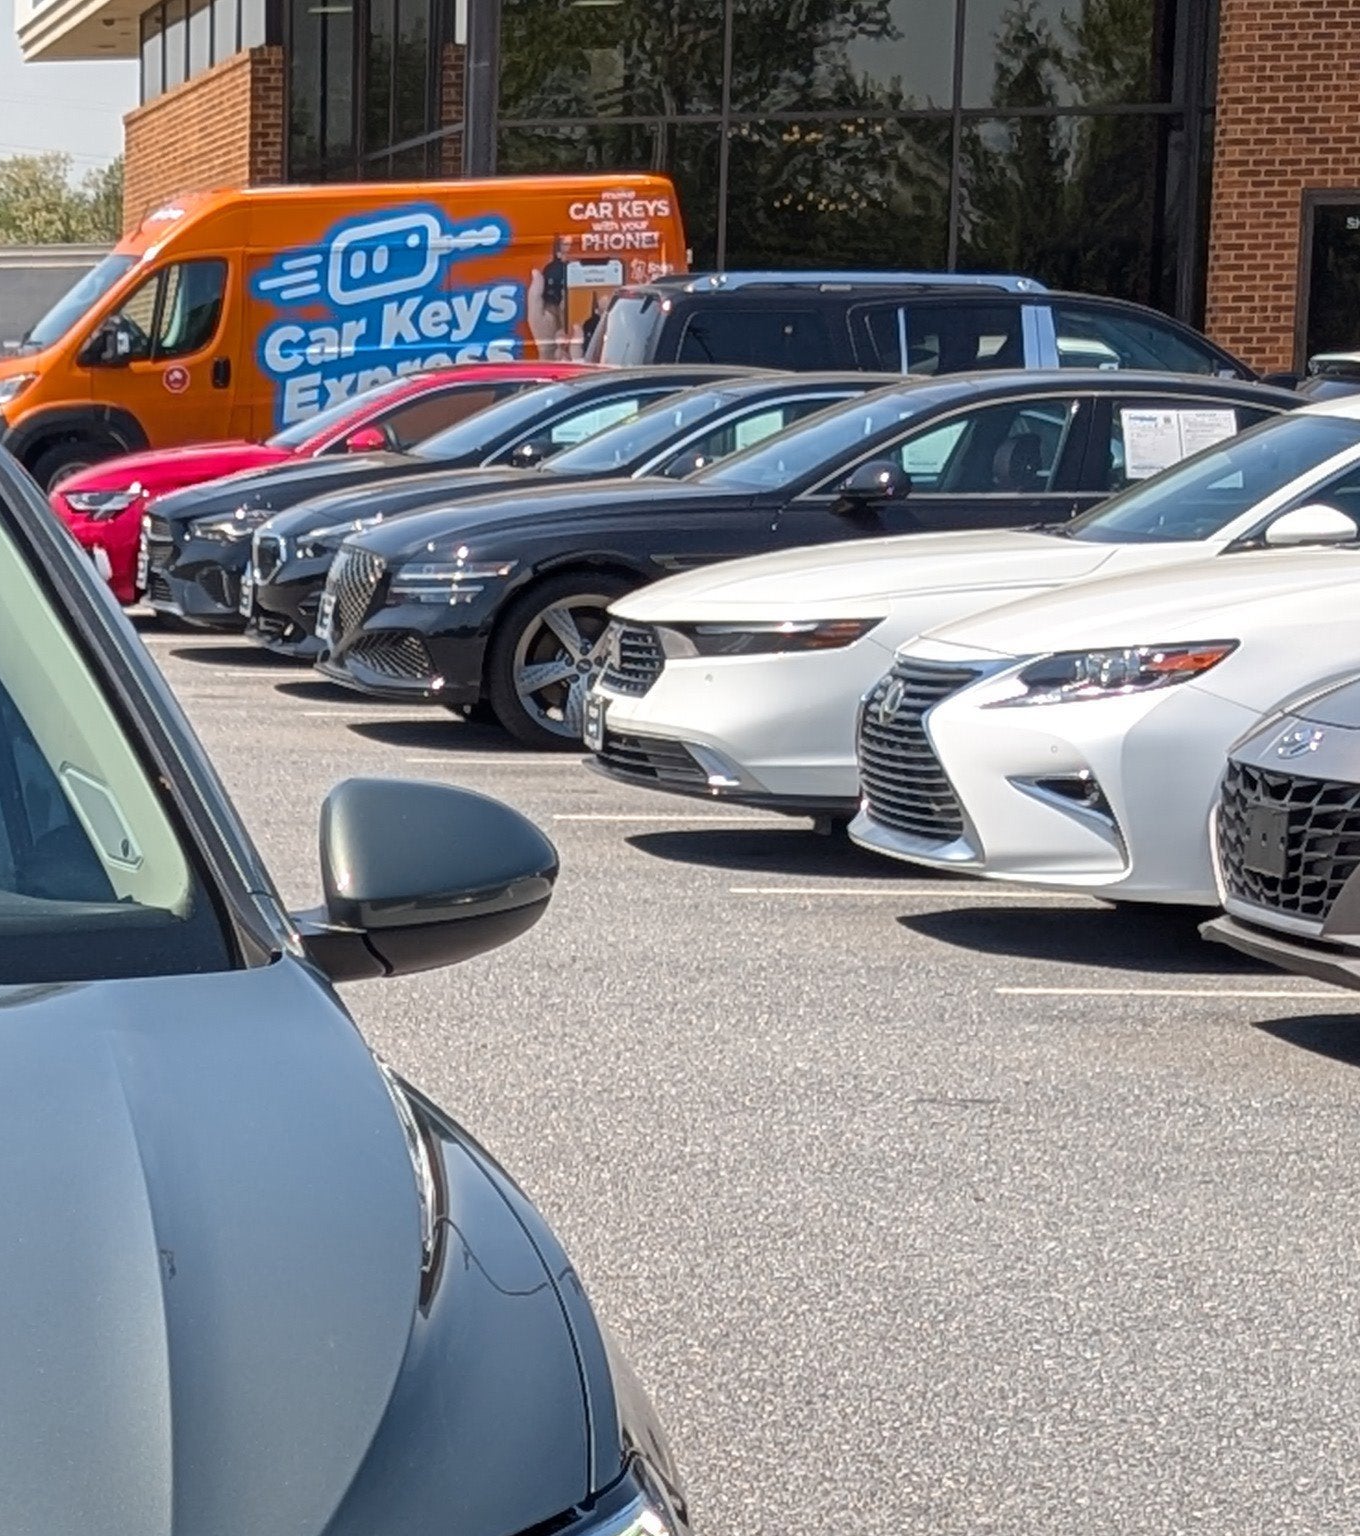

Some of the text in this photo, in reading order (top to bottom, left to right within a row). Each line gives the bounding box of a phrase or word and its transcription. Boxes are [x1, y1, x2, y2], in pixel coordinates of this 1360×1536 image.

[569, 199, 671, 220] CAR KEYS
[264, 285, 518, 372] Car Keys
